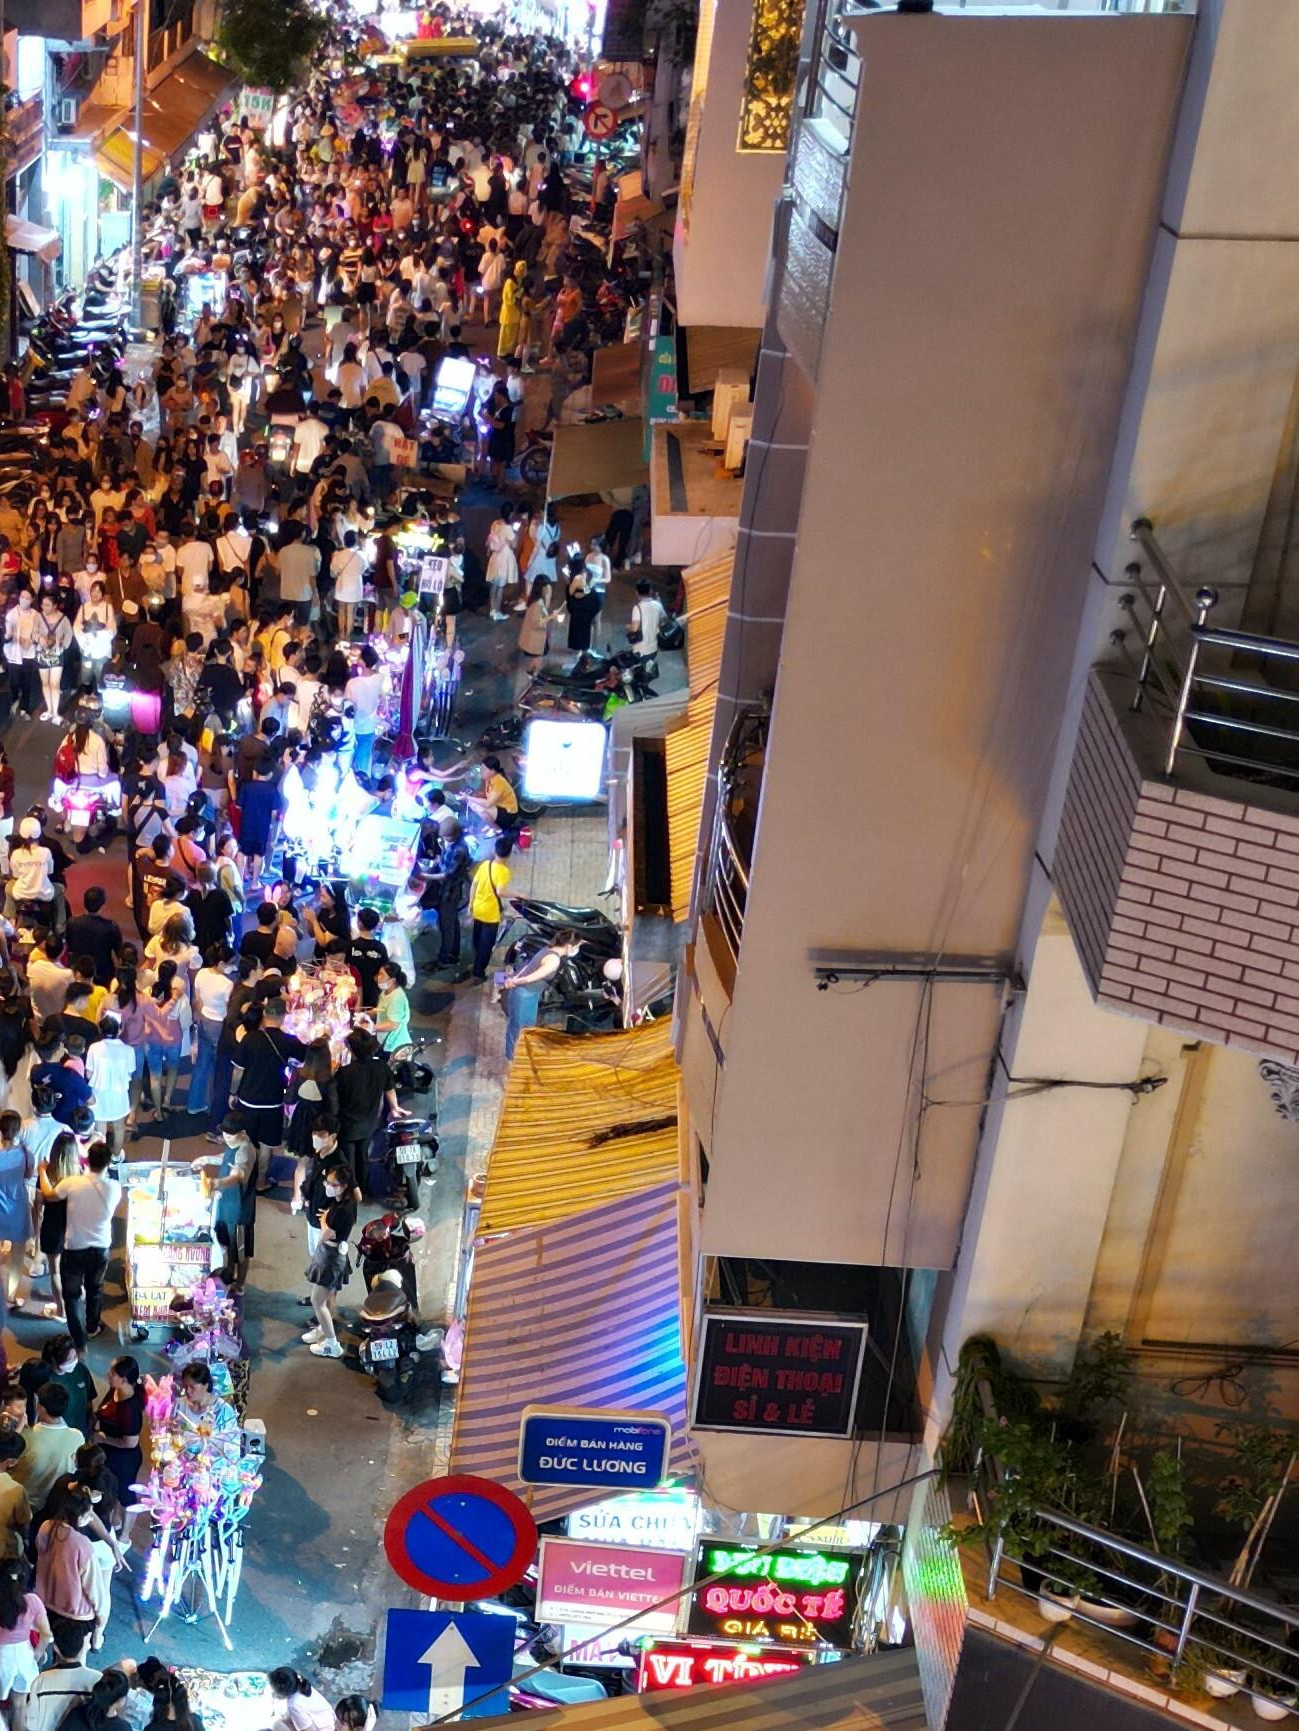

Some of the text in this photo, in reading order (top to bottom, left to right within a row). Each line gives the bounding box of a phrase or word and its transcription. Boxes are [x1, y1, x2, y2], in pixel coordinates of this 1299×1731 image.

[725, 1333, 843, 1362] LINH KIỆN
[713, 1364, 844, 1396] ĐIỆN THOẠI
[733, 1394, 816, 1424] SỈ & LẺ
[613, 1426, 662, 1436] mobifone
[545, 1435, 643, 1451] ĐIỂM BÁN HÀNG
[539, 1454, 647, 1474] ĐỨC LƯƠNG
[579, 1508, 621, 1529] SỬA
[569, 1561, 657, 1582] viettel
[554, 1583, 663, 1604] ĐIỂM BÁN VIETTE
[706, 1582, 845, 1619] QUỐC TẾ
[724, 1619, 770, 1637] GIÁ
[650, 1654, 695, 1686] VI
